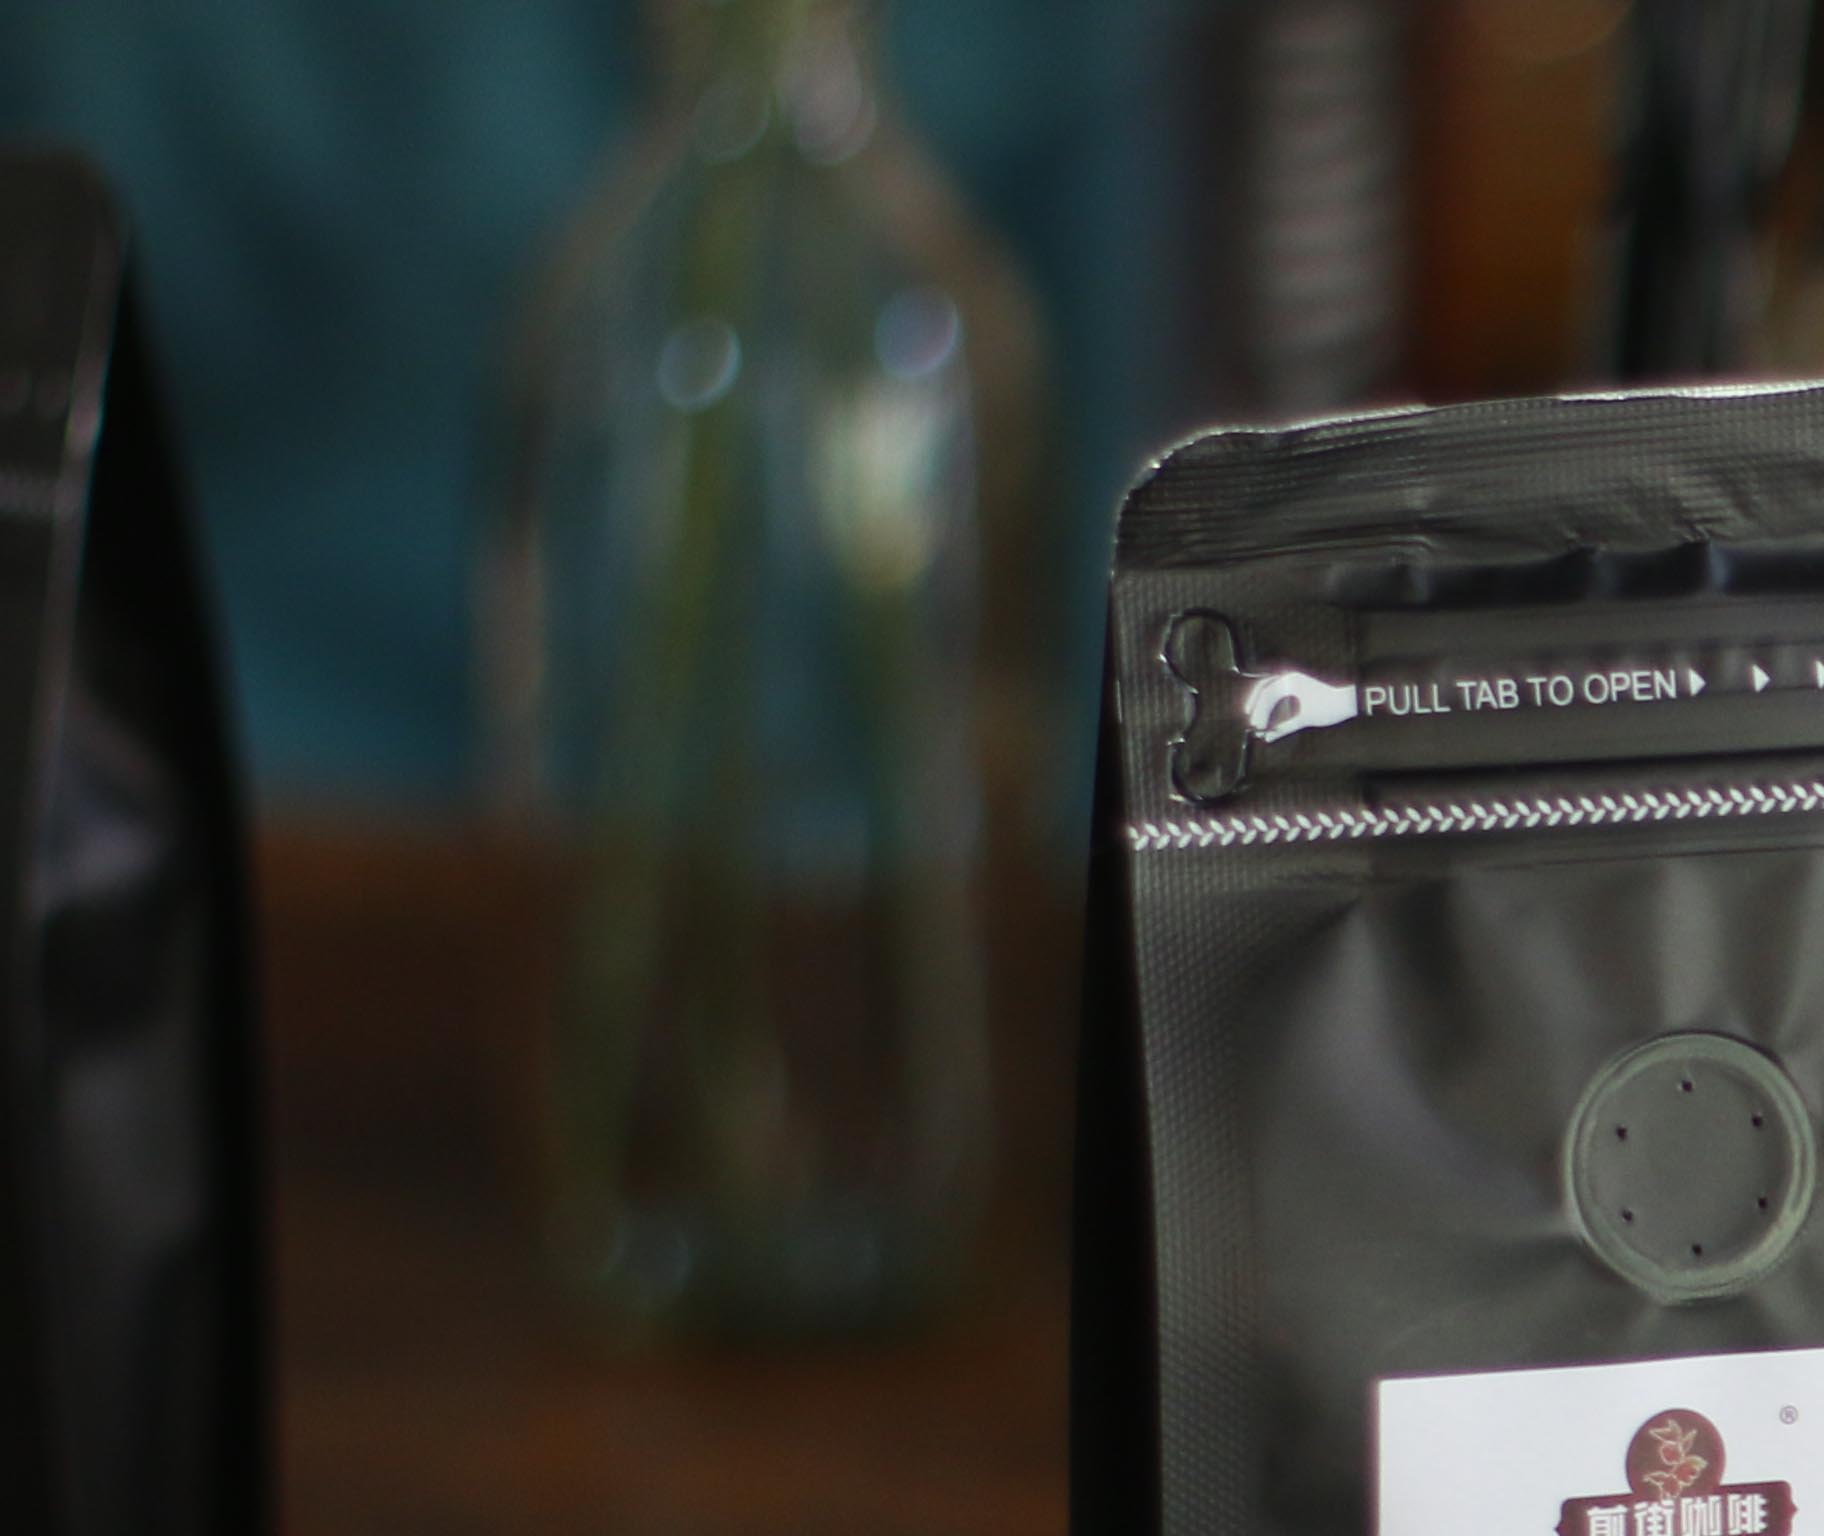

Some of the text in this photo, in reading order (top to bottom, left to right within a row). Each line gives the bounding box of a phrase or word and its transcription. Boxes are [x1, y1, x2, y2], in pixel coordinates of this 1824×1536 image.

[1365, 669, 1677, 715] PULL TAB TO OPEN
